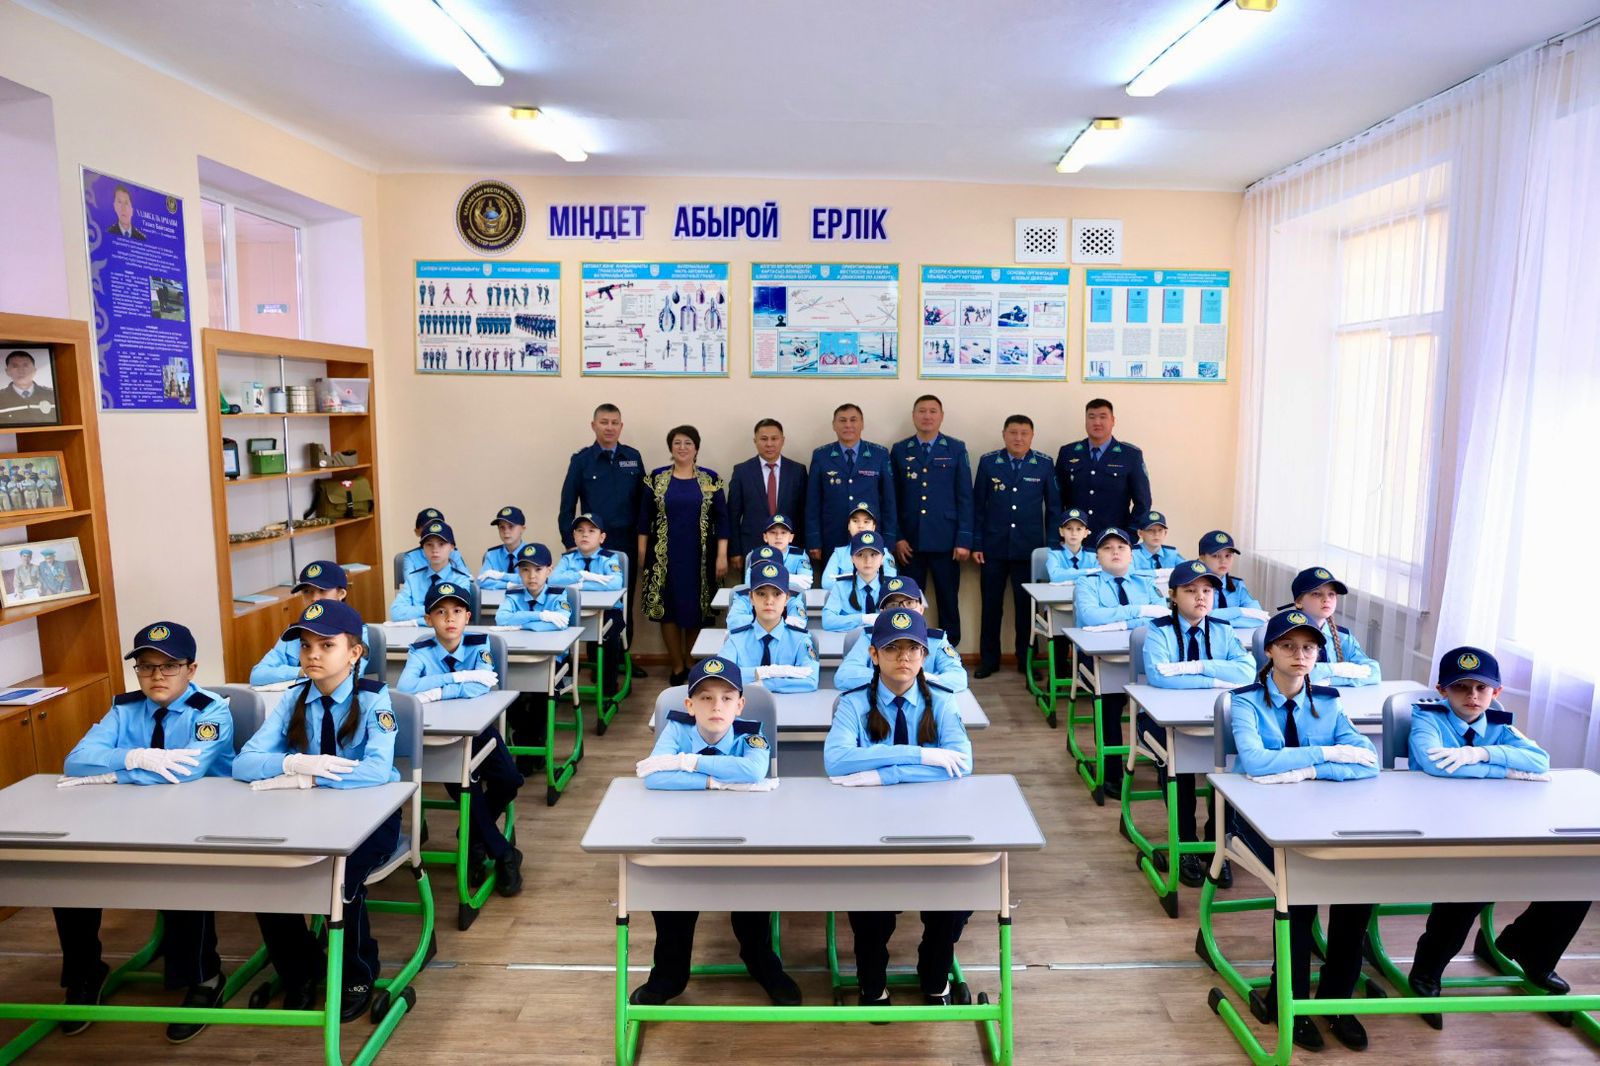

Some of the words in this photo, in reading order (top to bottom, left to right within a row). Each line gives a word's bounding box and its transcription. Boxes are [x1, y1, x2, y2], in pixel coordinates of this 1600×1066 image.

[550, 206, 645, 239] МІНДЕТ
[674, 202, 778, 238] АБЫРОЙ
[813, 208, 887, 239] ЕРЛІК
